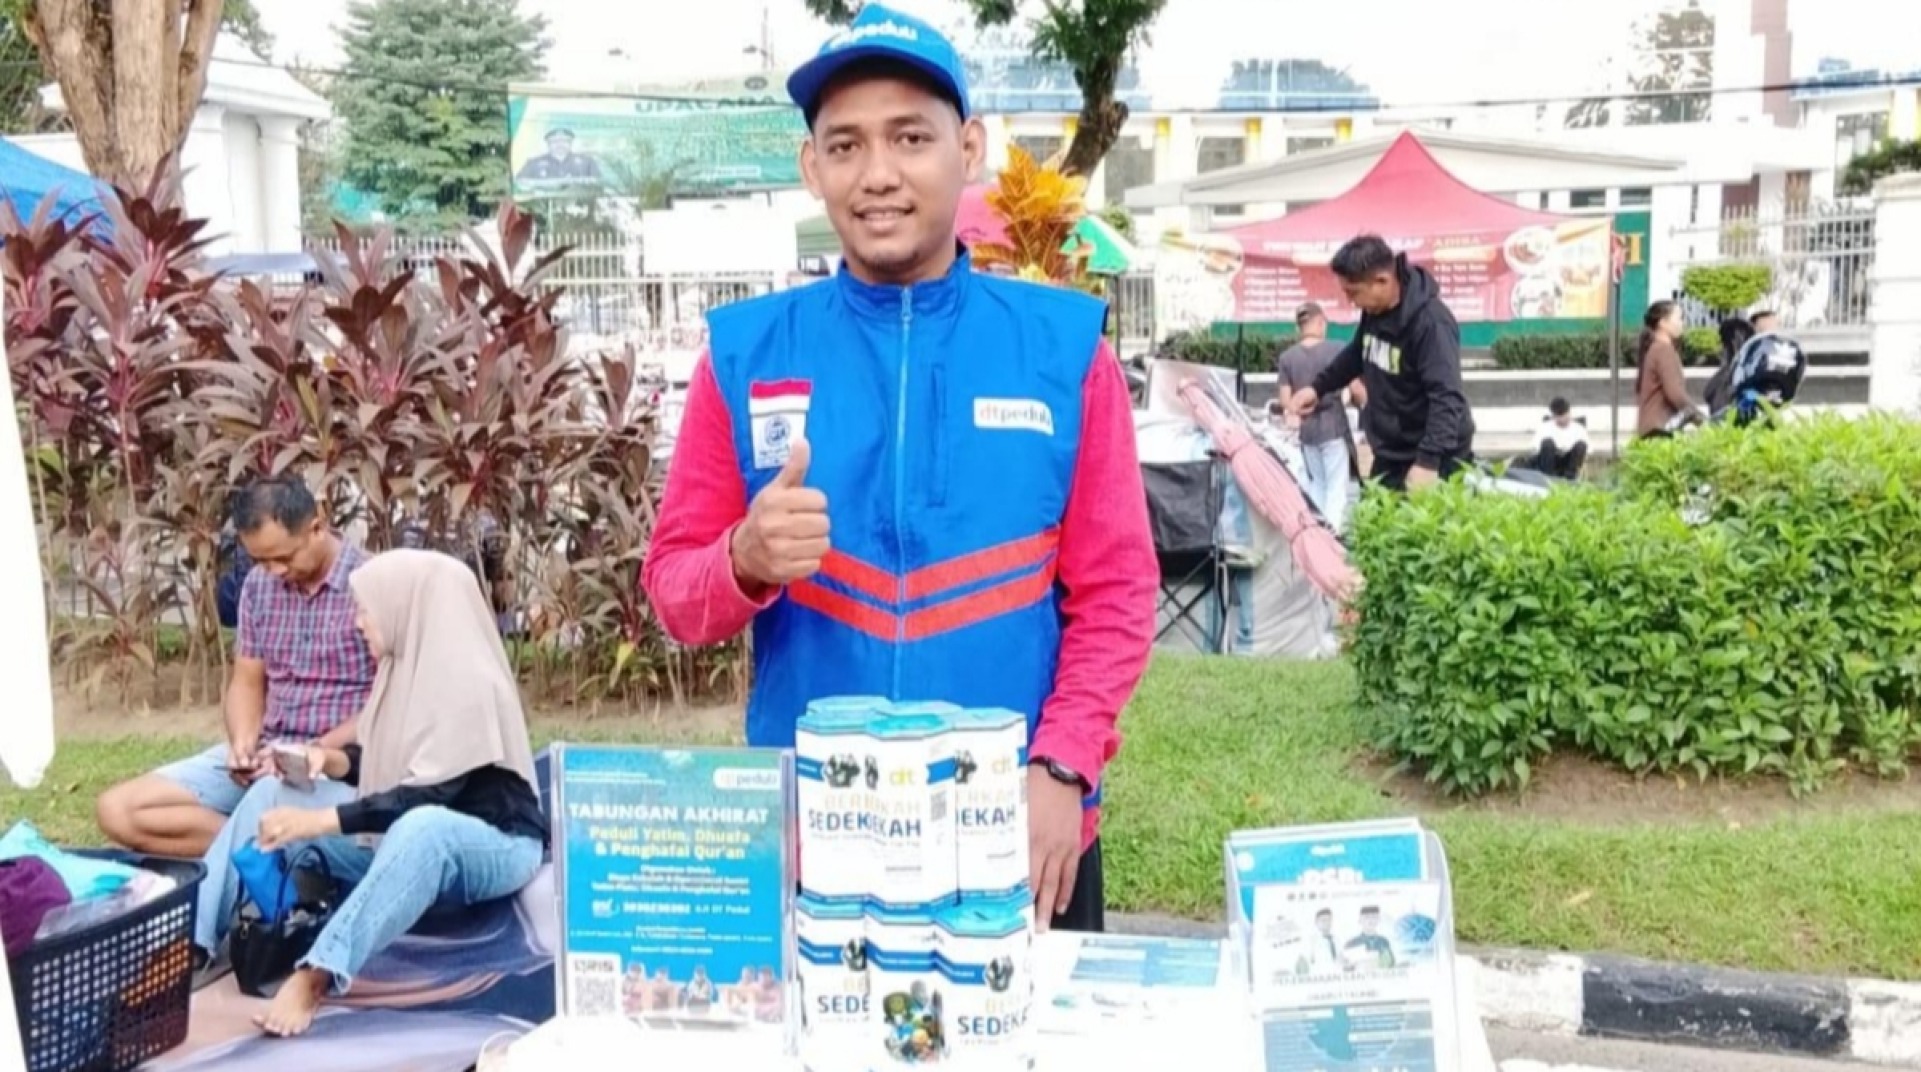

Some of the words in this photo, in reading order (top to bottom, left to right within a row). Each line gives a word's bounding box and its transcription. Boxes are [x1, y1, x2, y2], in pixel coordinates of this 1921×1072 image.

[889, 766, 916, 786] dt
[569, 803, 679, 821] TABUNGAN
[683, 805, 769, 823] AKHIRAT
[590, 824, 638, 841] Peduli
[695, 829, 750, 844] Dhuafa
[595, 844, 607, 857] &
[611, 843, 690, 860] Penghafal
[694, 845, 746, 862] Qur'an
